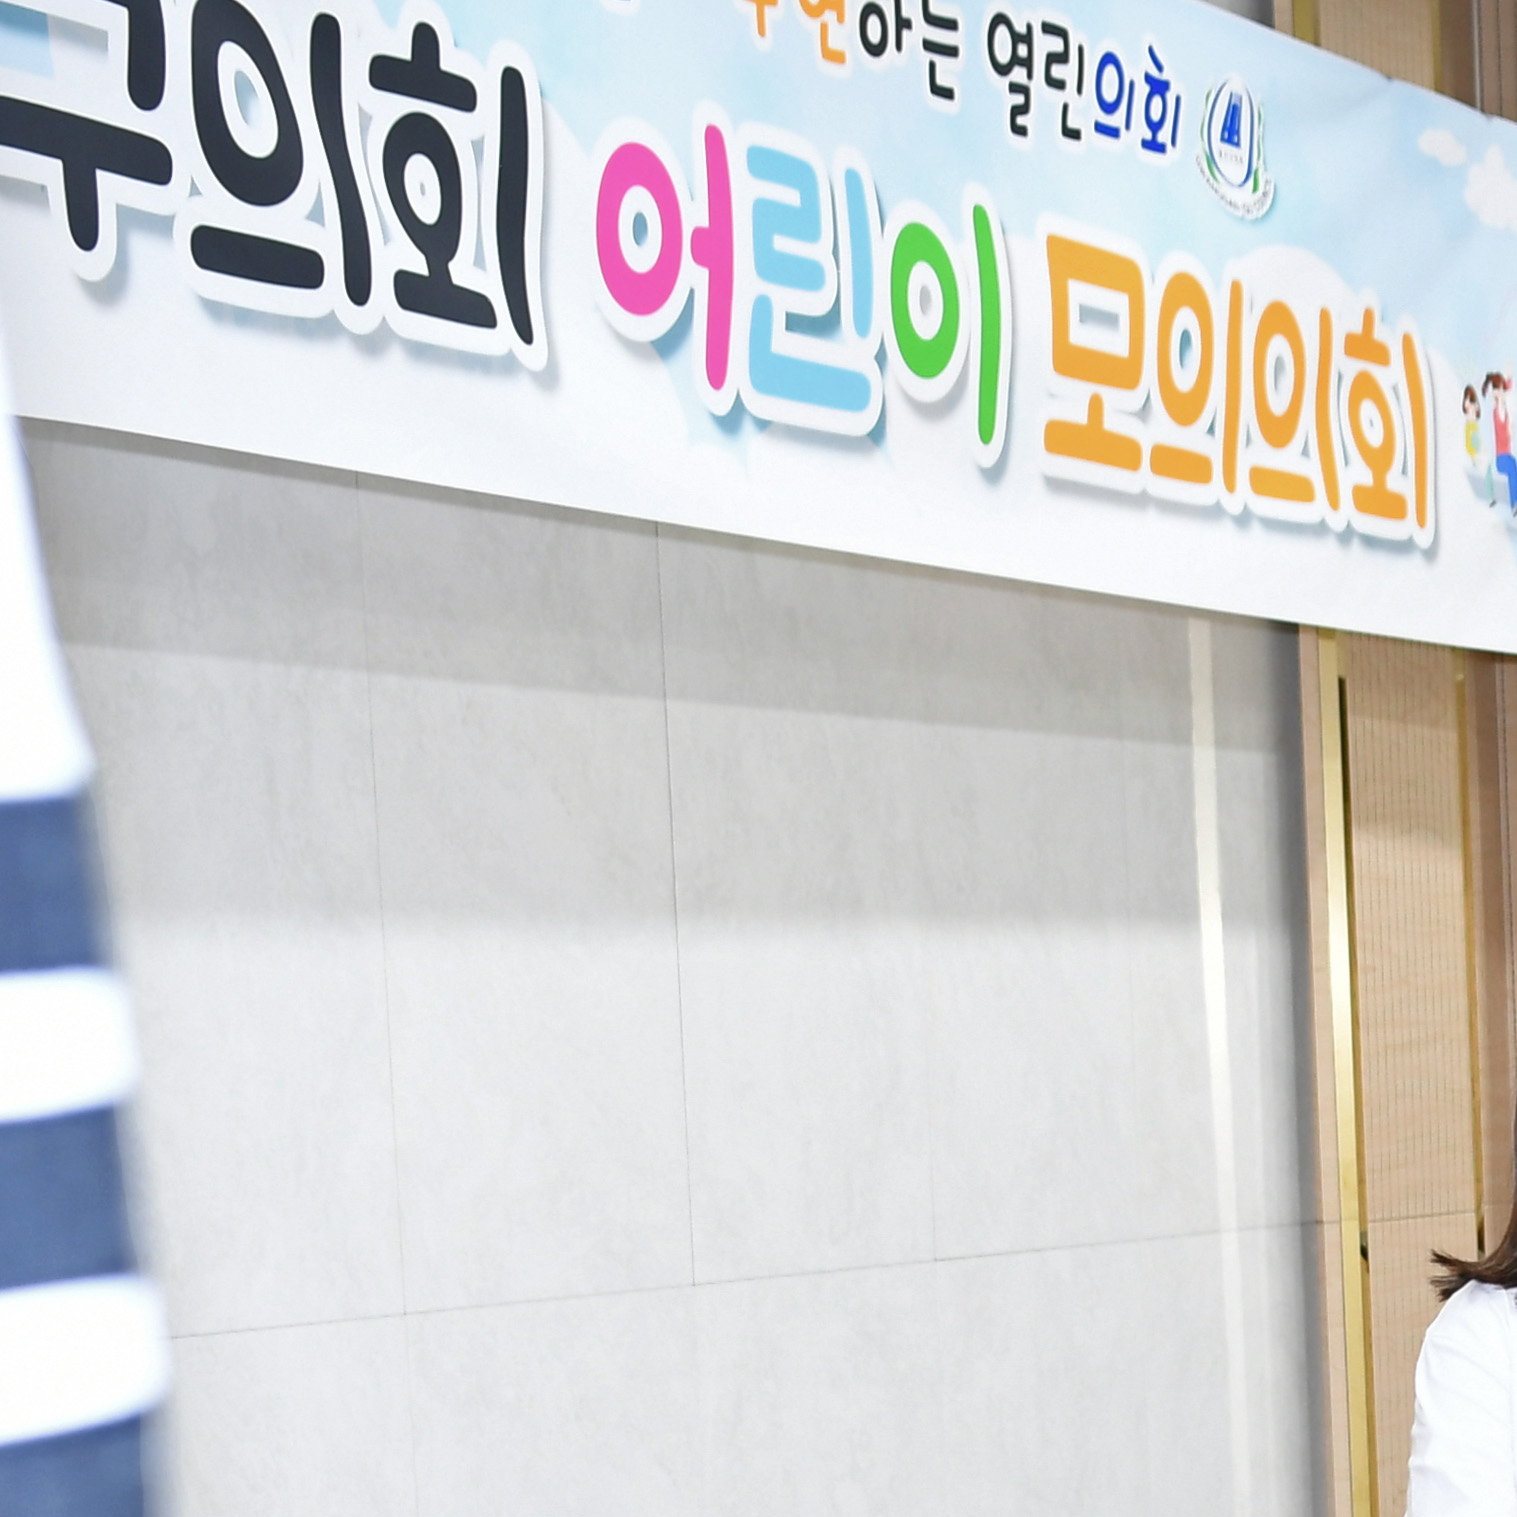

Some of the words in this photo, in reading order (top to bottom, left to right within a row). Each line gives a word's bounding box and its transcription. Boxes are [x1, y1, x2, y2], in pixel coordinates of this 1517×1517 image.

[987, 11, 1181, 154] 열린의회
[596, 123, 999, 447] 어린이
[1043, 233, 1428, 530] 모의의회
